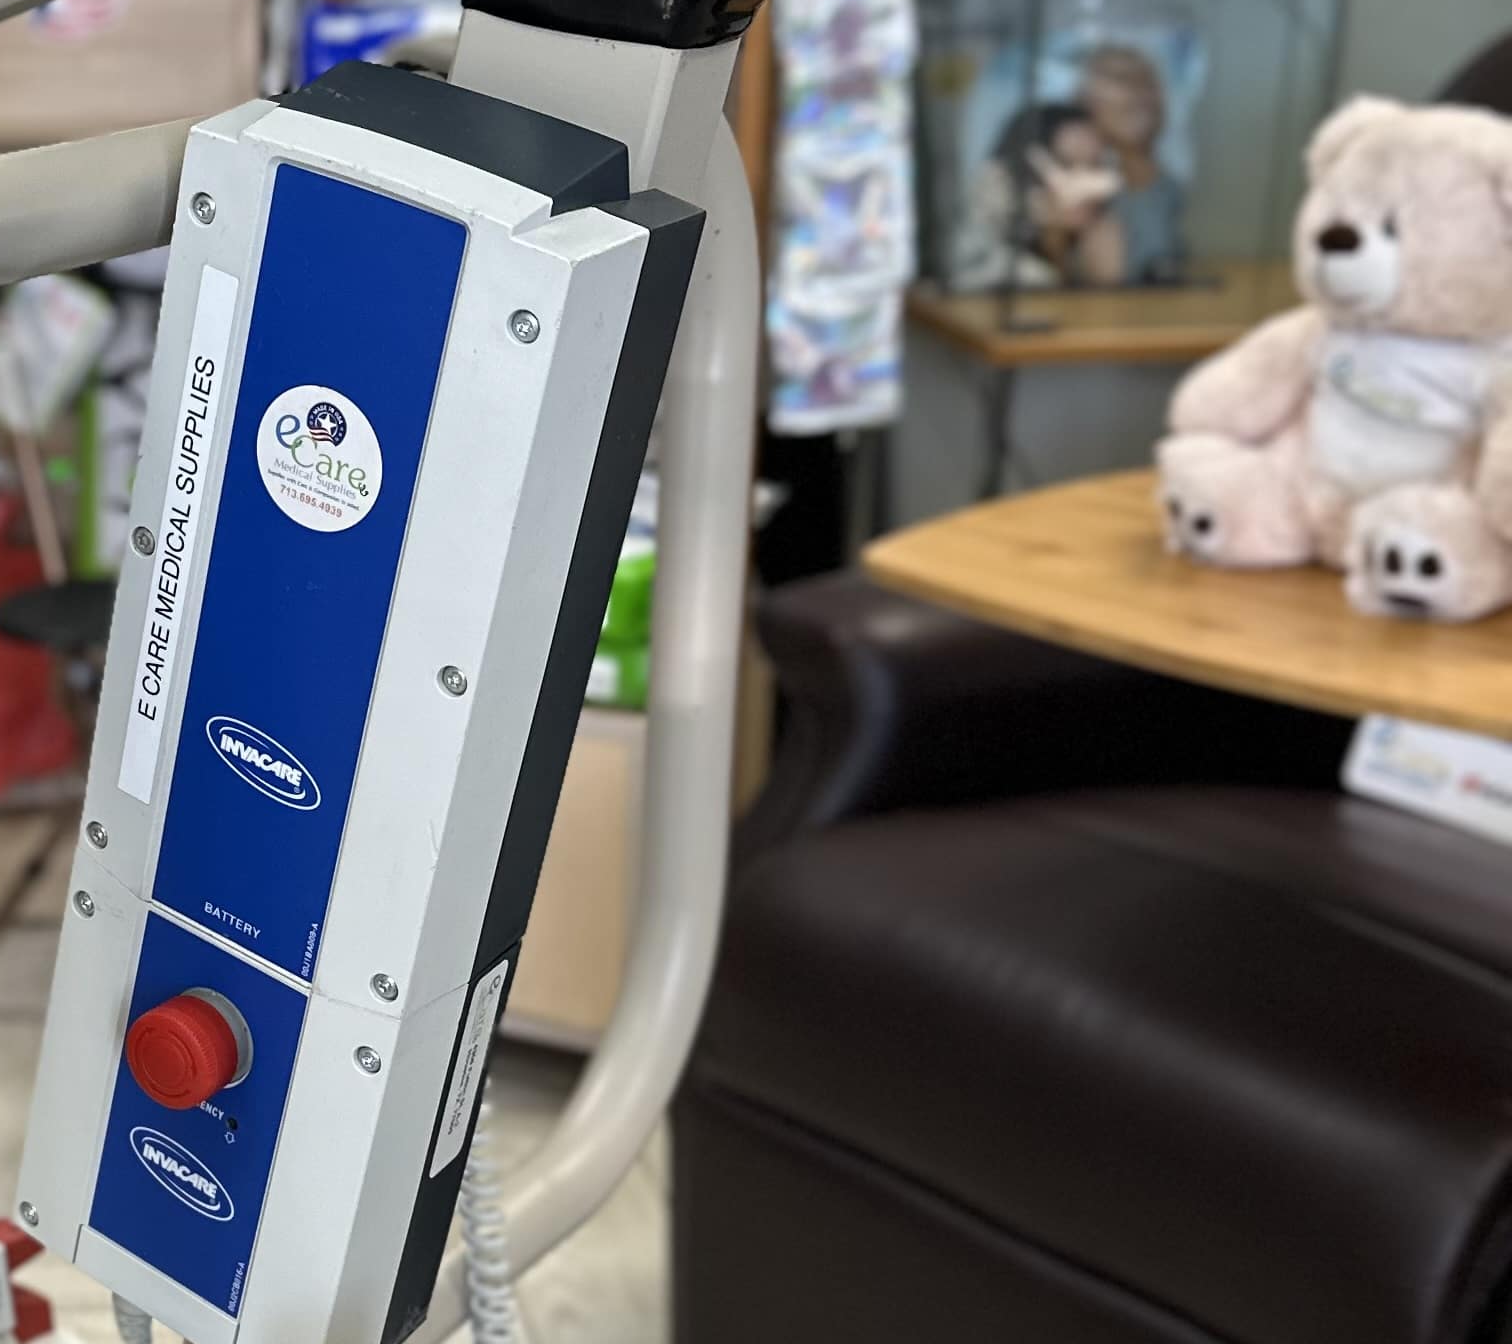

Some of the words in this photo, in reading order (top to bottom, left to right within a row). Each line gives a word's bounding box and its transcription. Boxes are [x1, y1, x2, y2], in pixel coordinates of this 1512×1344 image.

[175, 355, 215, 495] SUPPLIES
[276, 414, 366, 491] eCare
[274, 458, 314, 481] Medical
[316, 475, 357, 500] Supplies
[154, 503, 192, 621] MEDICAL
[142, 620, 170, 696] CARE
[137, 698, 157, 721] E
[220, 733, 303, 788] INVACARE
[204, 901, 262, 939] BATTERY
[142, 1143, 218, 1200] INVACARE
